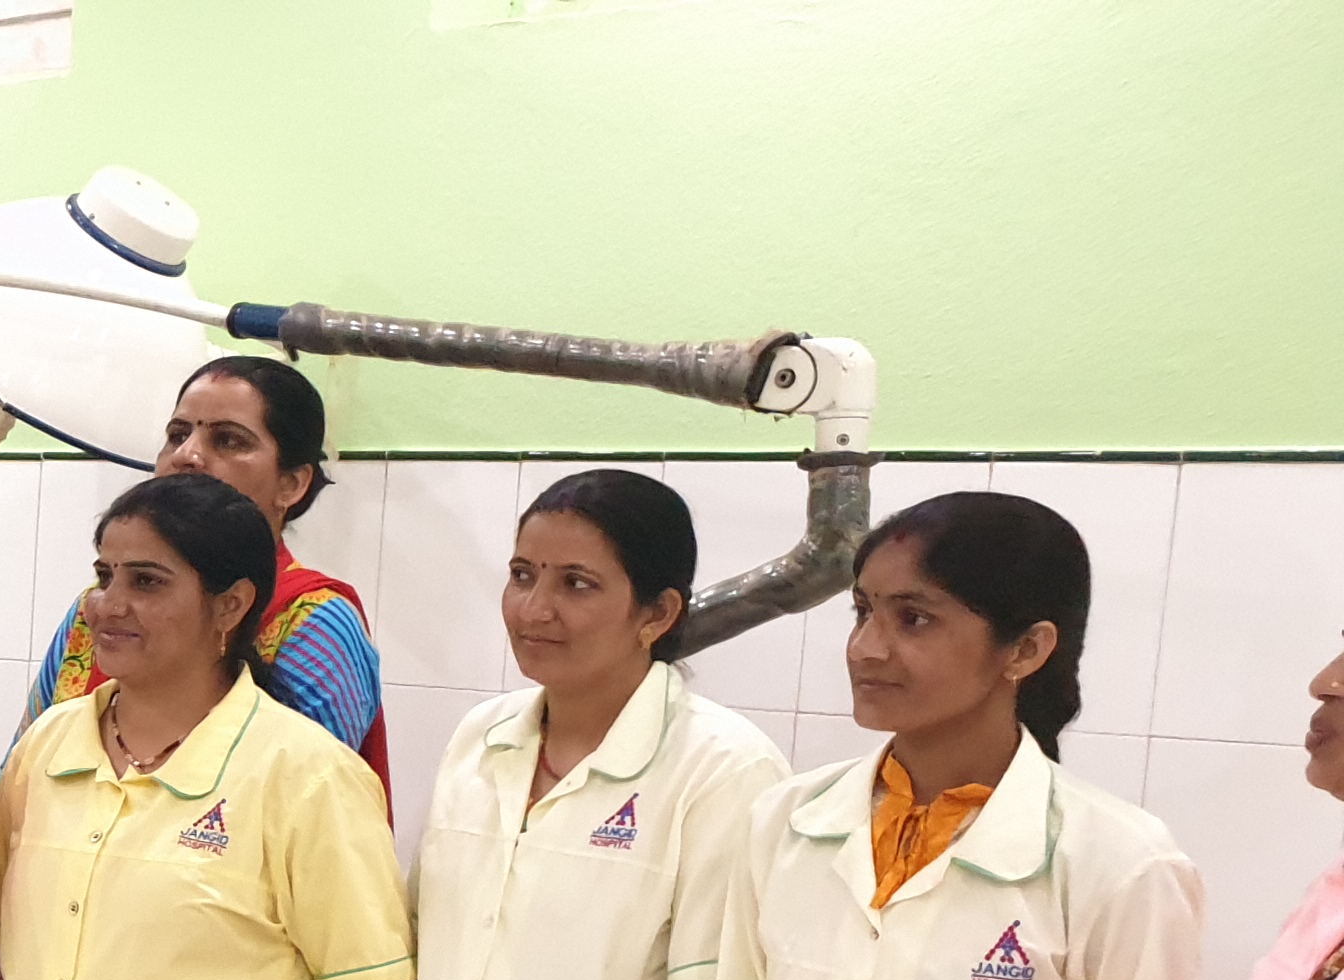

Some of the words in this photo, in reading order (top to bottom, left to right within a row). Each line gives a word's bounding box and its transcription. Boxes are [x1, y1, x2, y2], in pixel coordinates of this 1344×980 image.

[180, 828, 229, 846] JANGID
[589, 838, 632, 850] HOSPITAL
[178, 837, 223, 857] HOSPITAL
[972, 962, 1035, 979] JANGID
